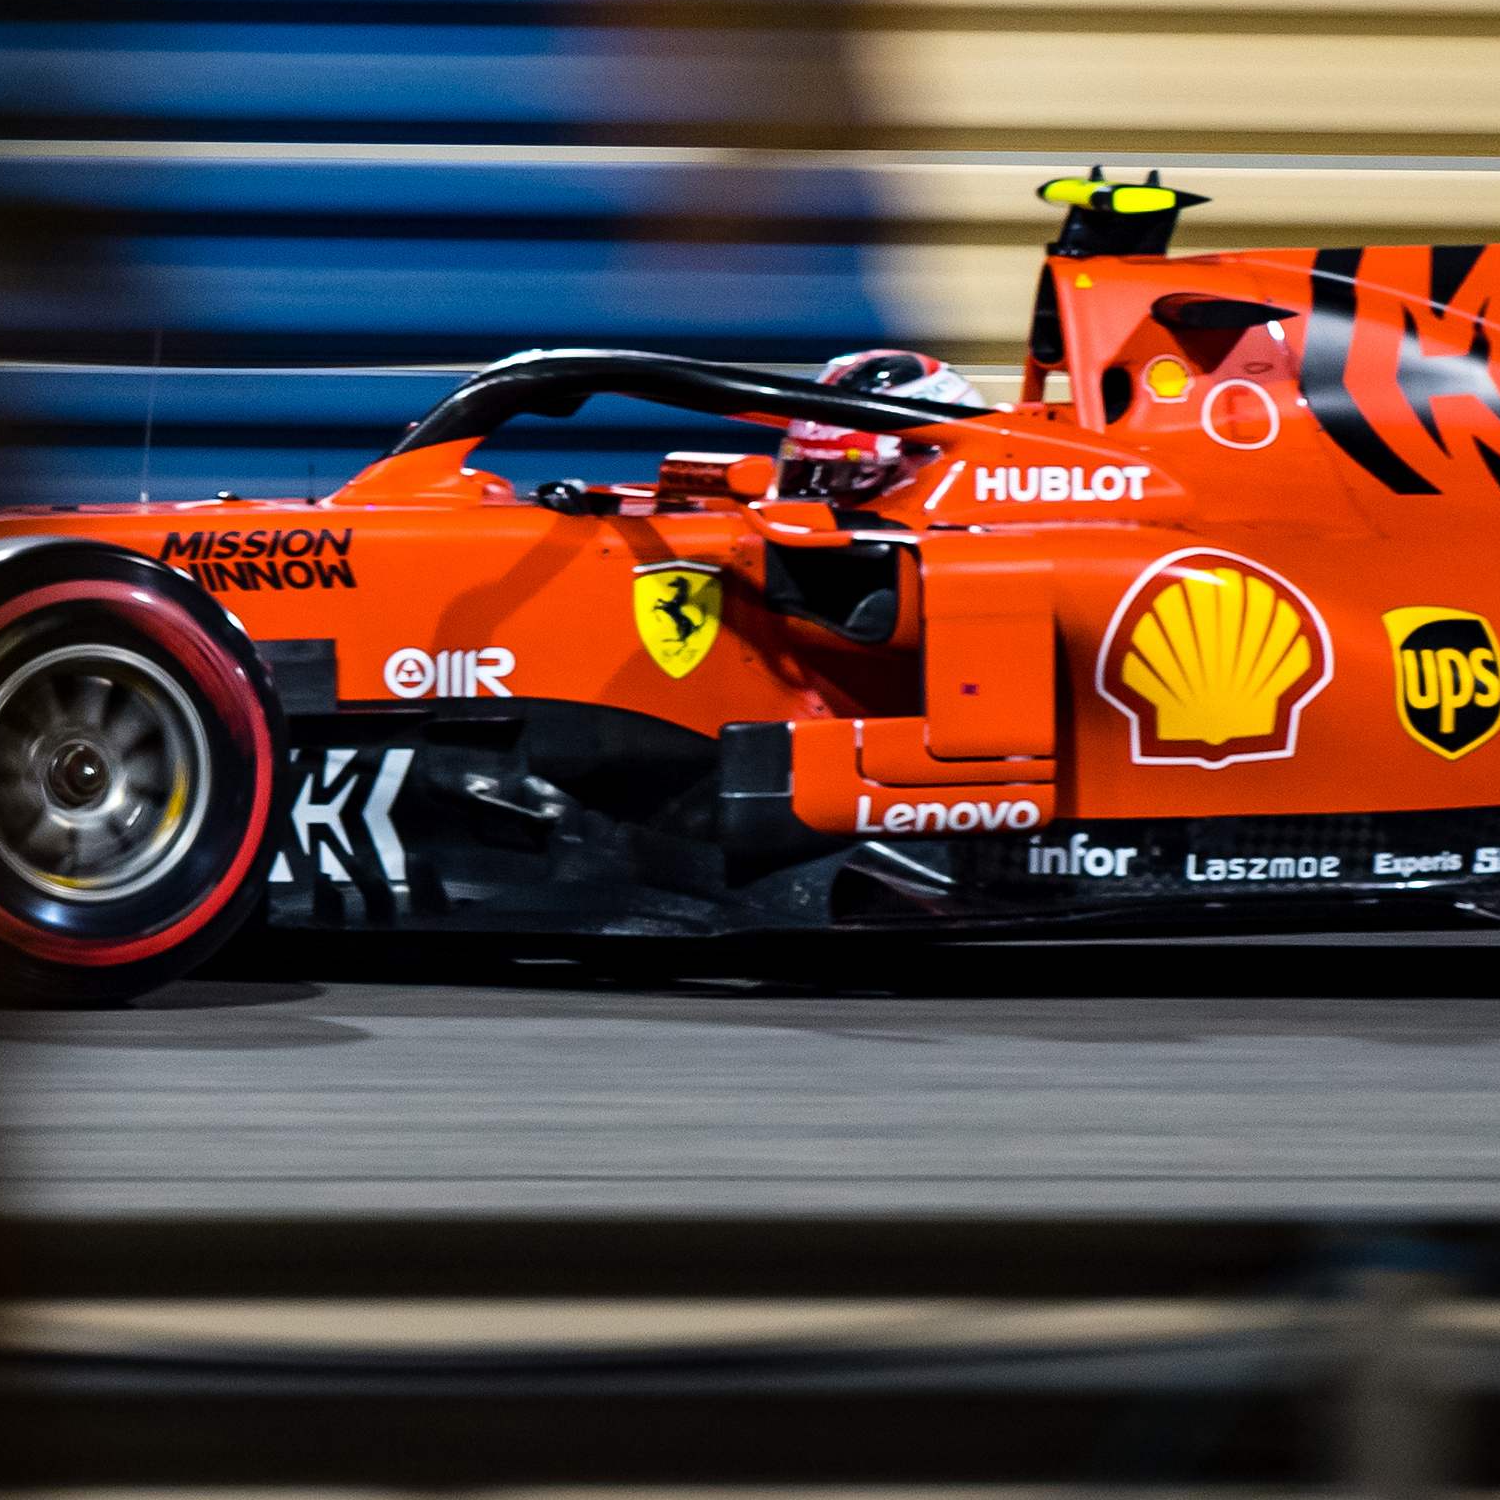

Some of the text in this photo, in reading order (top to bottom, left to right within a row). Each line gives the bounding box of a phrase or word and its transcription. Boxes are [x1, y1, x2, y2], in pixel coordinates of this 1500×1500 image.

[974, 465, 1151, 502] HUBLOT
[158, 528, 353, 562] MISSION
[855, 794, 1041, 834] Lenovo
[1028, 832, 1138, 878] infor
